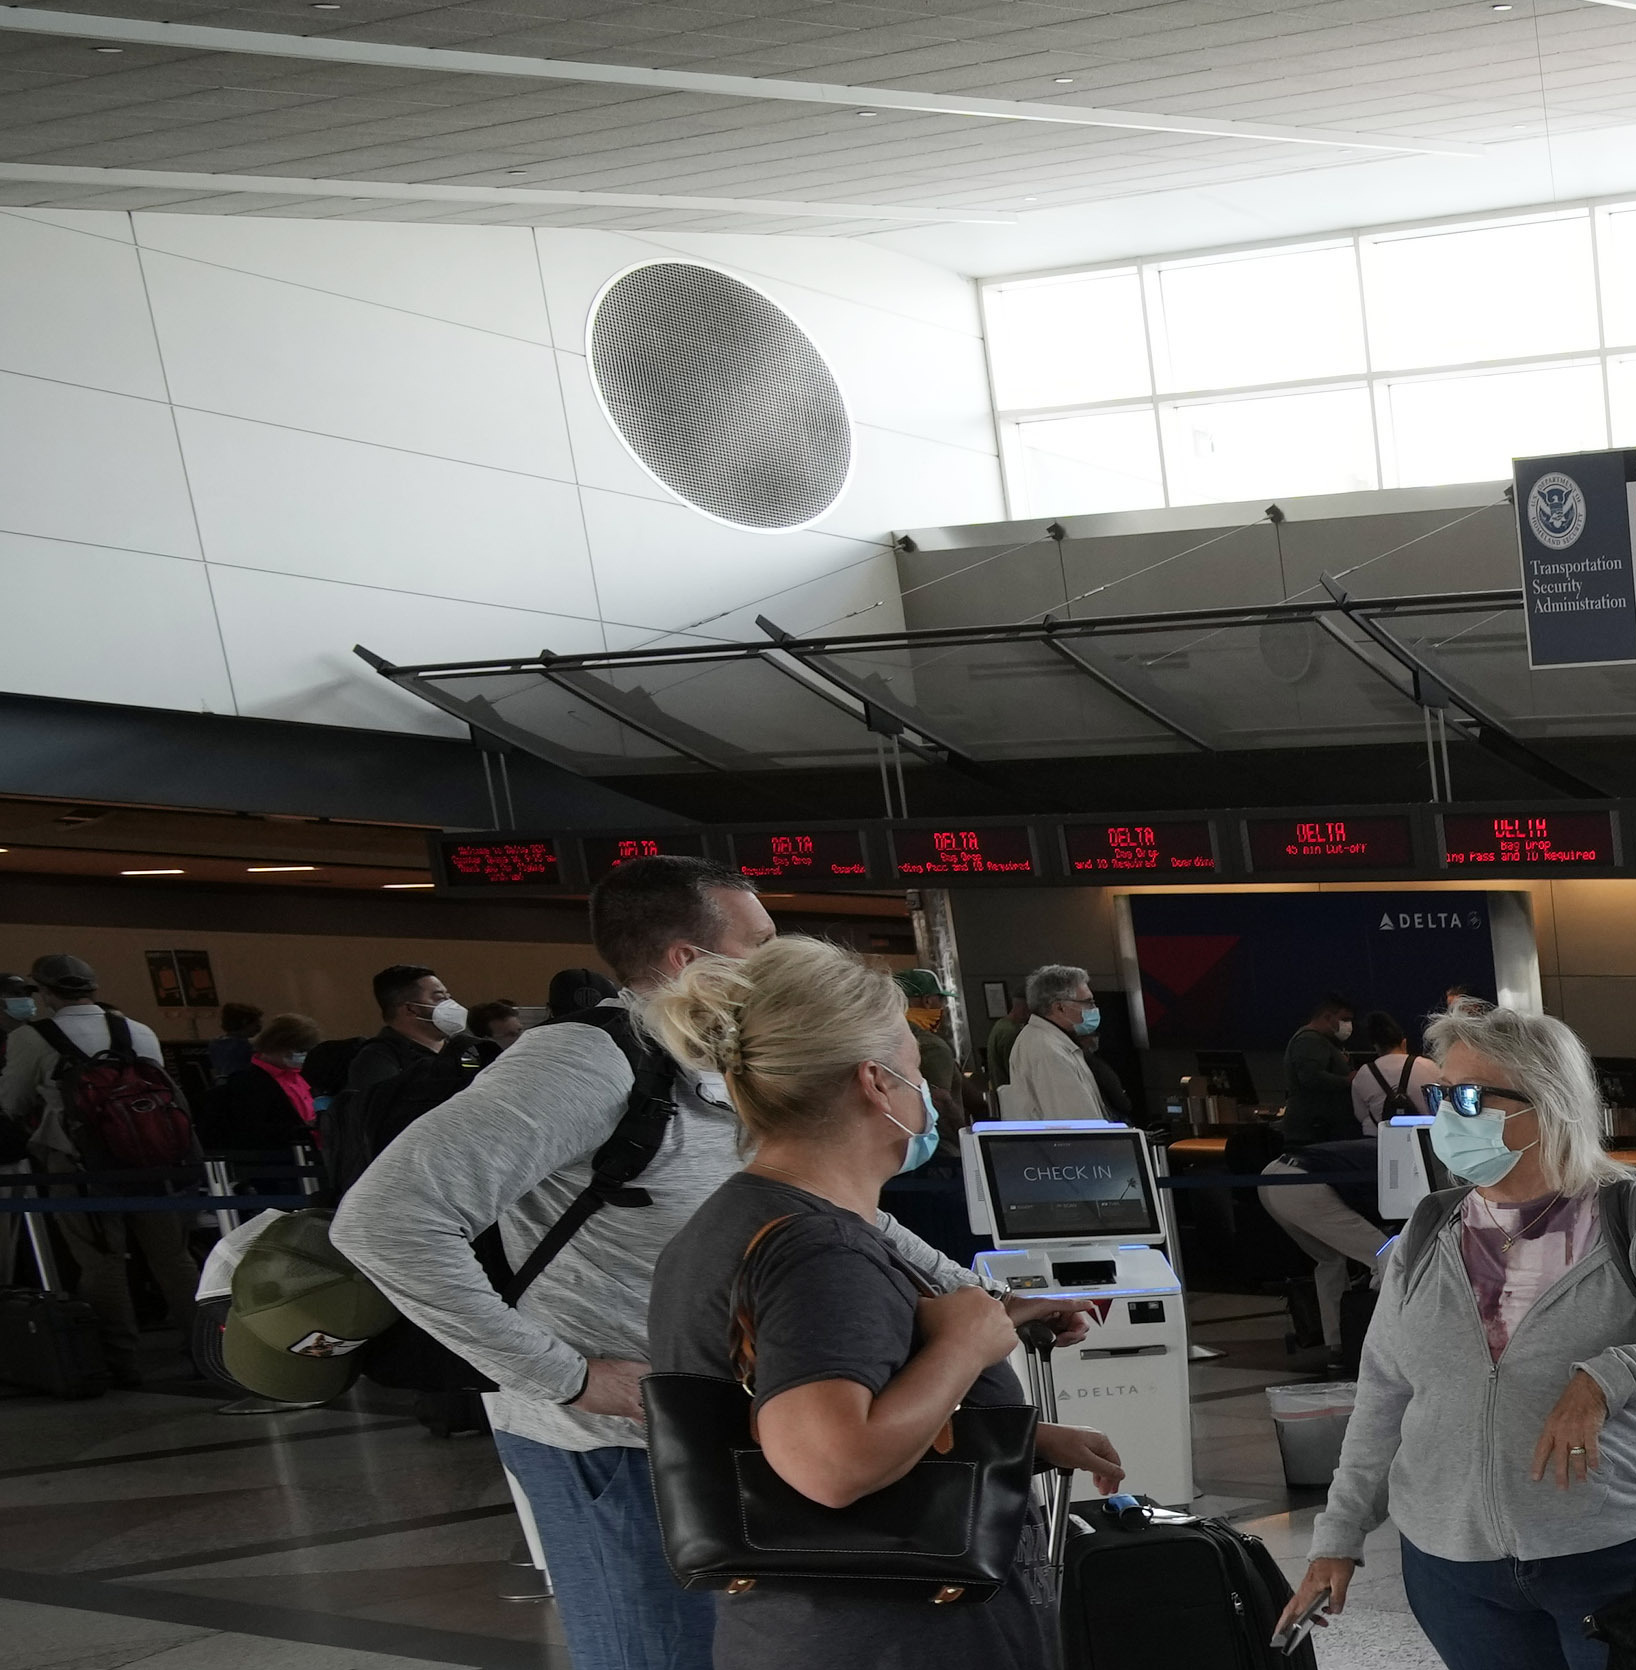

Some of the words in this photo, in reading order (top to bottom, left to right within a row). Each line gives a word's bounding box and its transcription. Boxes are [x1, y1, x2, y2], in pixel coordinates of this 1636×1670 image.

[1529, 555, 1622, 576] Transportation
[1532, 576, 1582, 600] Security
[1534, 594, 1626, 613] Administration
[933, 831, 978, 850] DELTA
[1108, 827, 1154, 847] DELTA
[1297, 823, 1346, 843] DELTA
[1399, 913, 1462, 928] DELTA
[1023, 1164, 1089, 1182] CHECK
[1092, 1164, 1113, 1180] IN
[1077, 1384, 1139, 1399] DELTA
